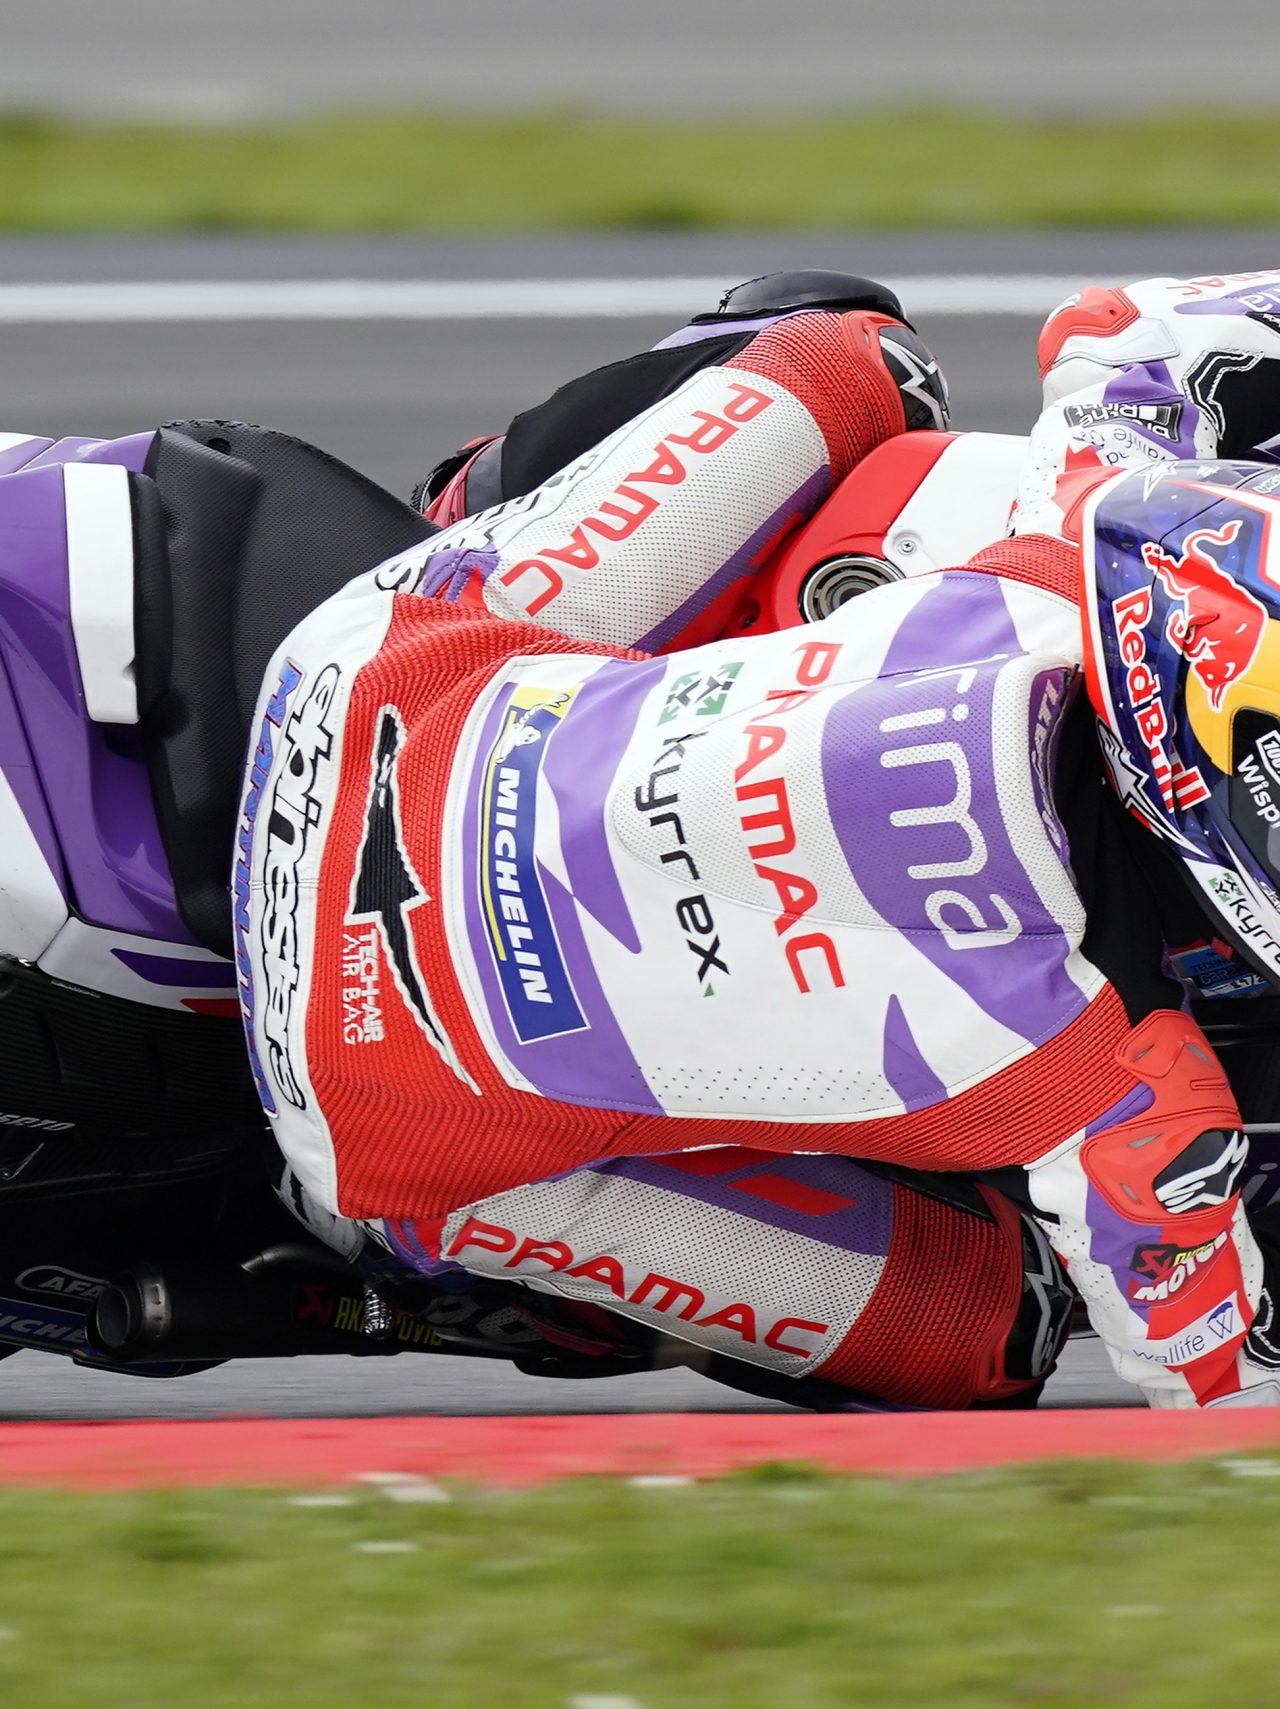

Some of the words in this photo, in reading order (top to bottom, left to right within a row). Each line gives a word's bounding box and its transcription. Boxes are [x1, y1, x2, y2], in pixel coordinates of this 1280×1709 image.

[499, 382, 774, 618] PRAMAC
[1112, 585, 1162, 707] Red
[494, 767, 554, 1005] MICHELIN
[634, 731, 732, 985] kyrrex
[733, 641, 847, 994] PRAMAC
[877, 653, 1024, 951] rima
[342, 933, 360, 977] AIR
[342, 987, 363, 1046] BAG
[447, 1218, 829, 1359] PRAMAC
[1133, 1335, 1206, 1364] wallife
